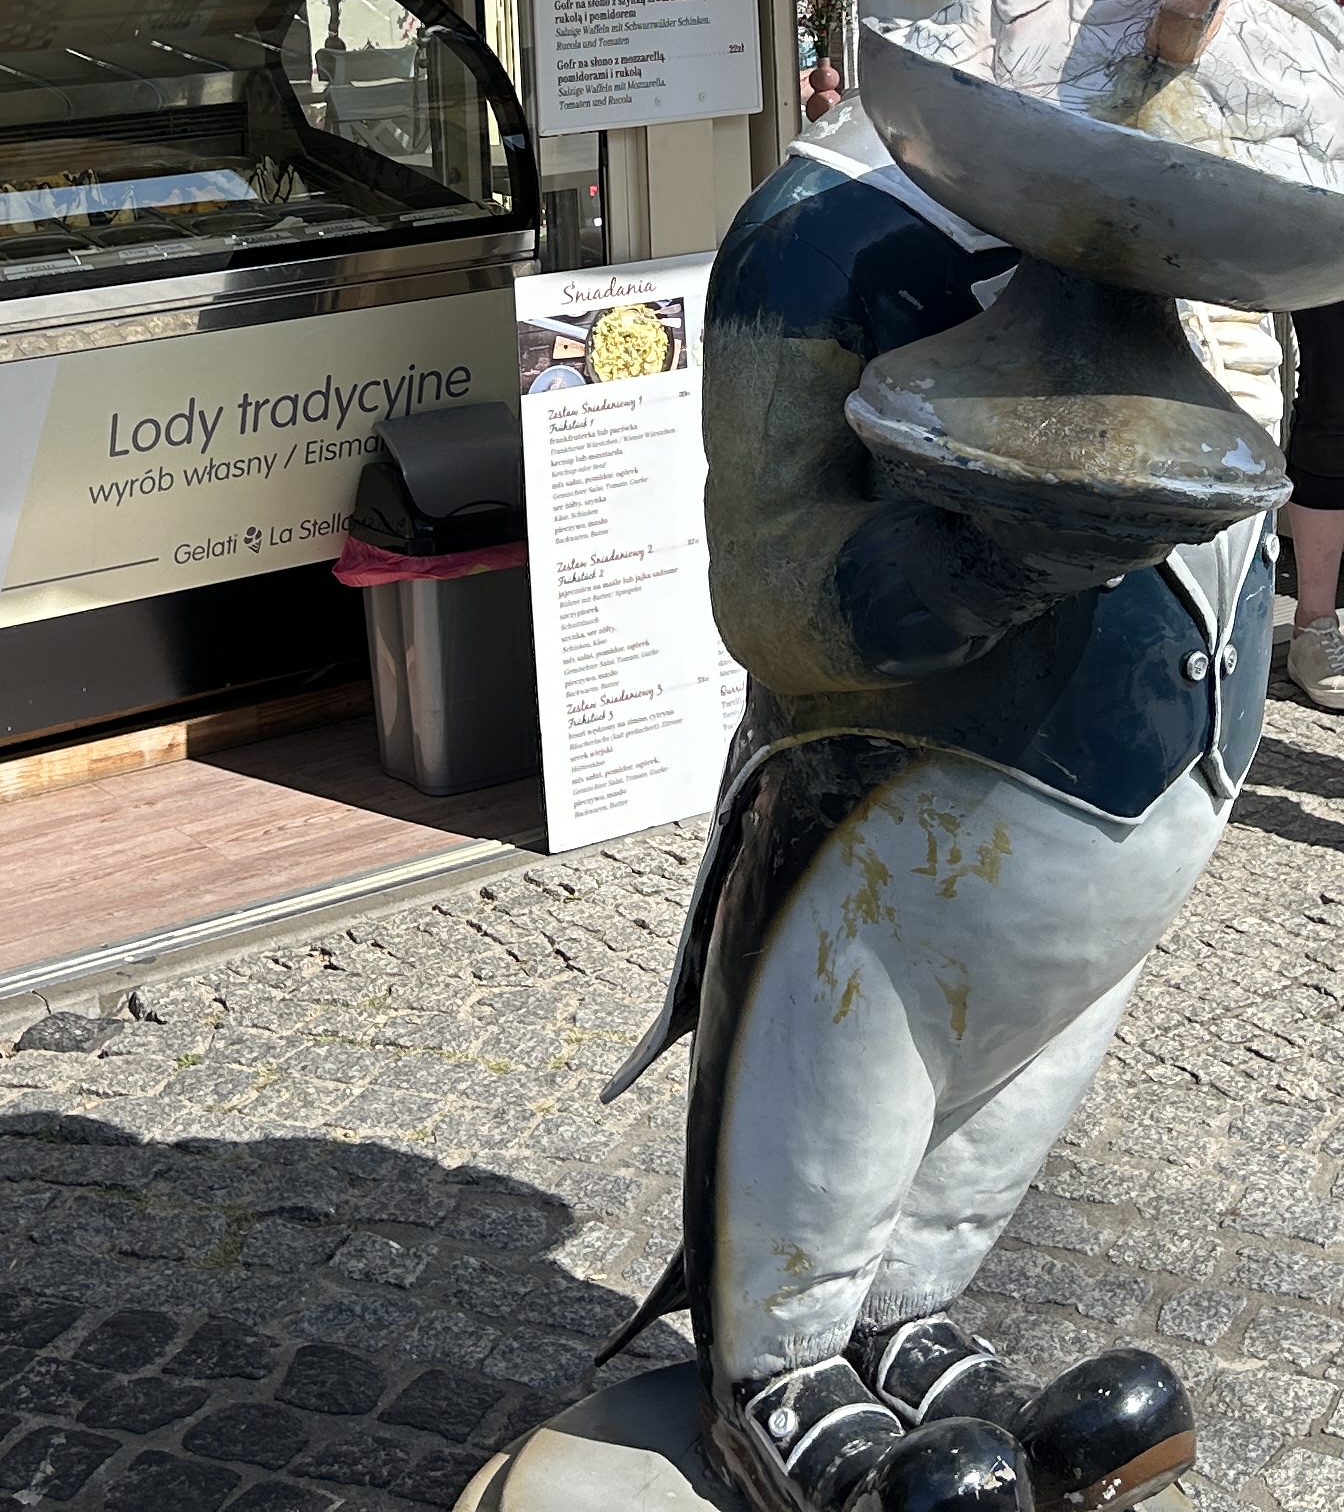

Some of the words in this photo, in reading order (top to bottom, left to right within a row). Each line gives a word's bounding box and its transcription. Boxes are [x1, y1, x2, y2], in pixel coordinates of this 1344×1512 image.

[561, 277, 657, 306] Śniadania
[109, 397, 224, 458] Lody
[238, 365, 473, 435] tradycyjne
[89, 466, 175, 507] wyrób
[183, 450, 279, 488] własny
[304, 432, 388, 467] Eisma
[173, 534, 239, 566] Gelati
[269, 522, 294, 548] La
